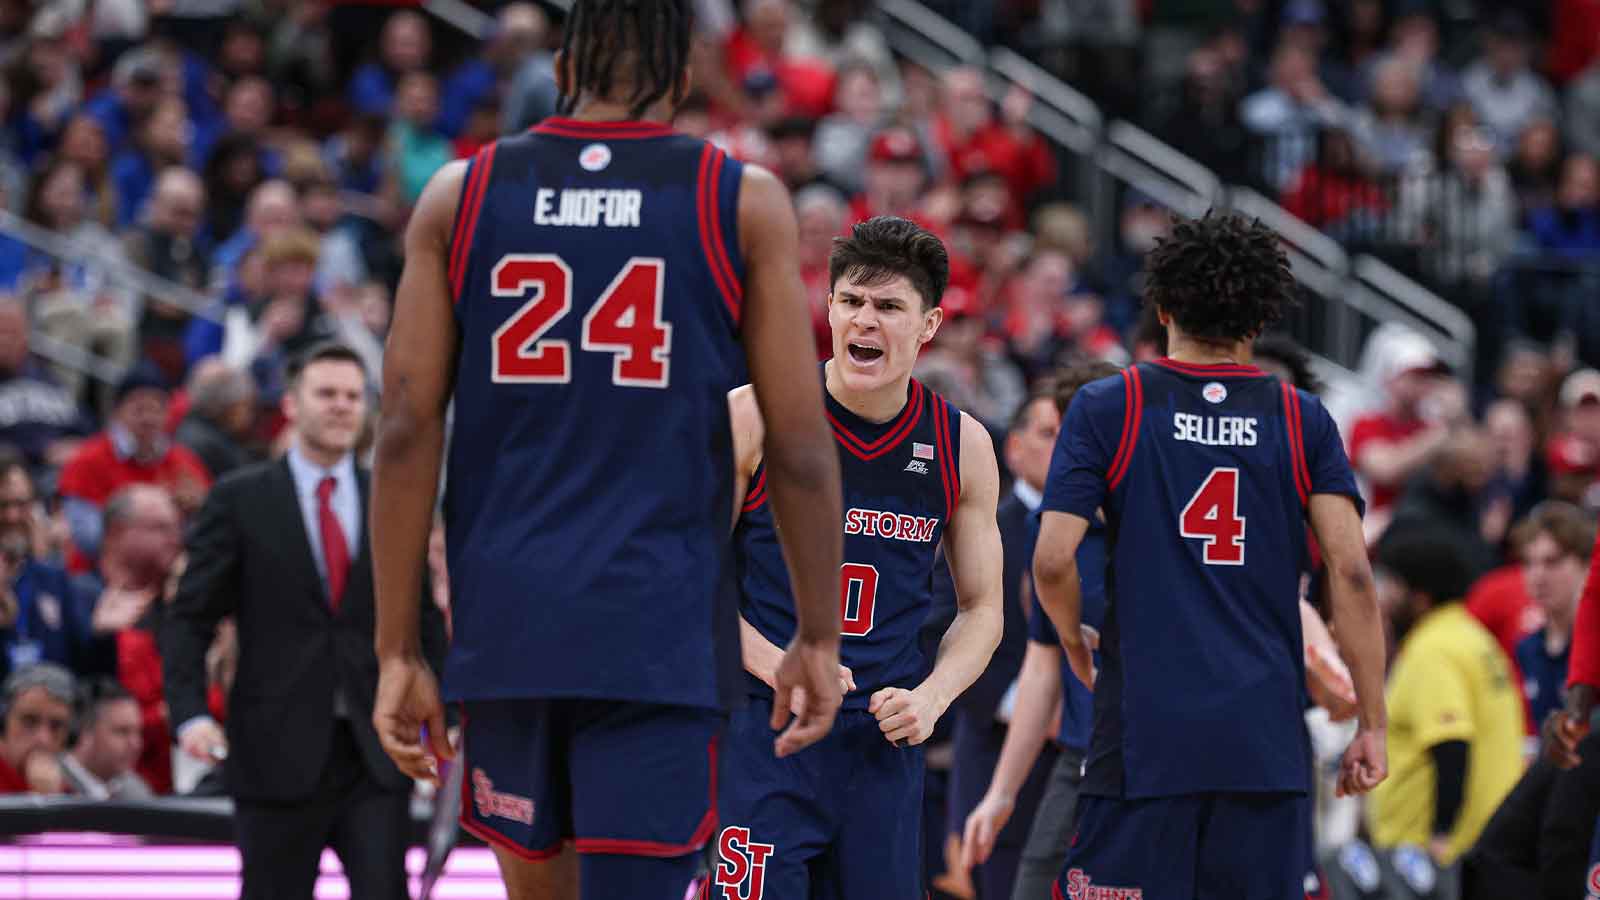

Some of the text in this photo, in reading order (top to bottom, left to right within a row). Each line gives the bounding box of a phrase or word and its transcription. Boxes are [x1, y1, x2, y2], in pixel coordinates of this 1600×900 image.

[534, 188, 642, 227] EJIOFOR
[490, 253, 673, 389] 24
[1173, 412, 1258, 447] SELLERS
[845, 508, 938, 542] STORM
[1179, 467, 1246, 566] 4
